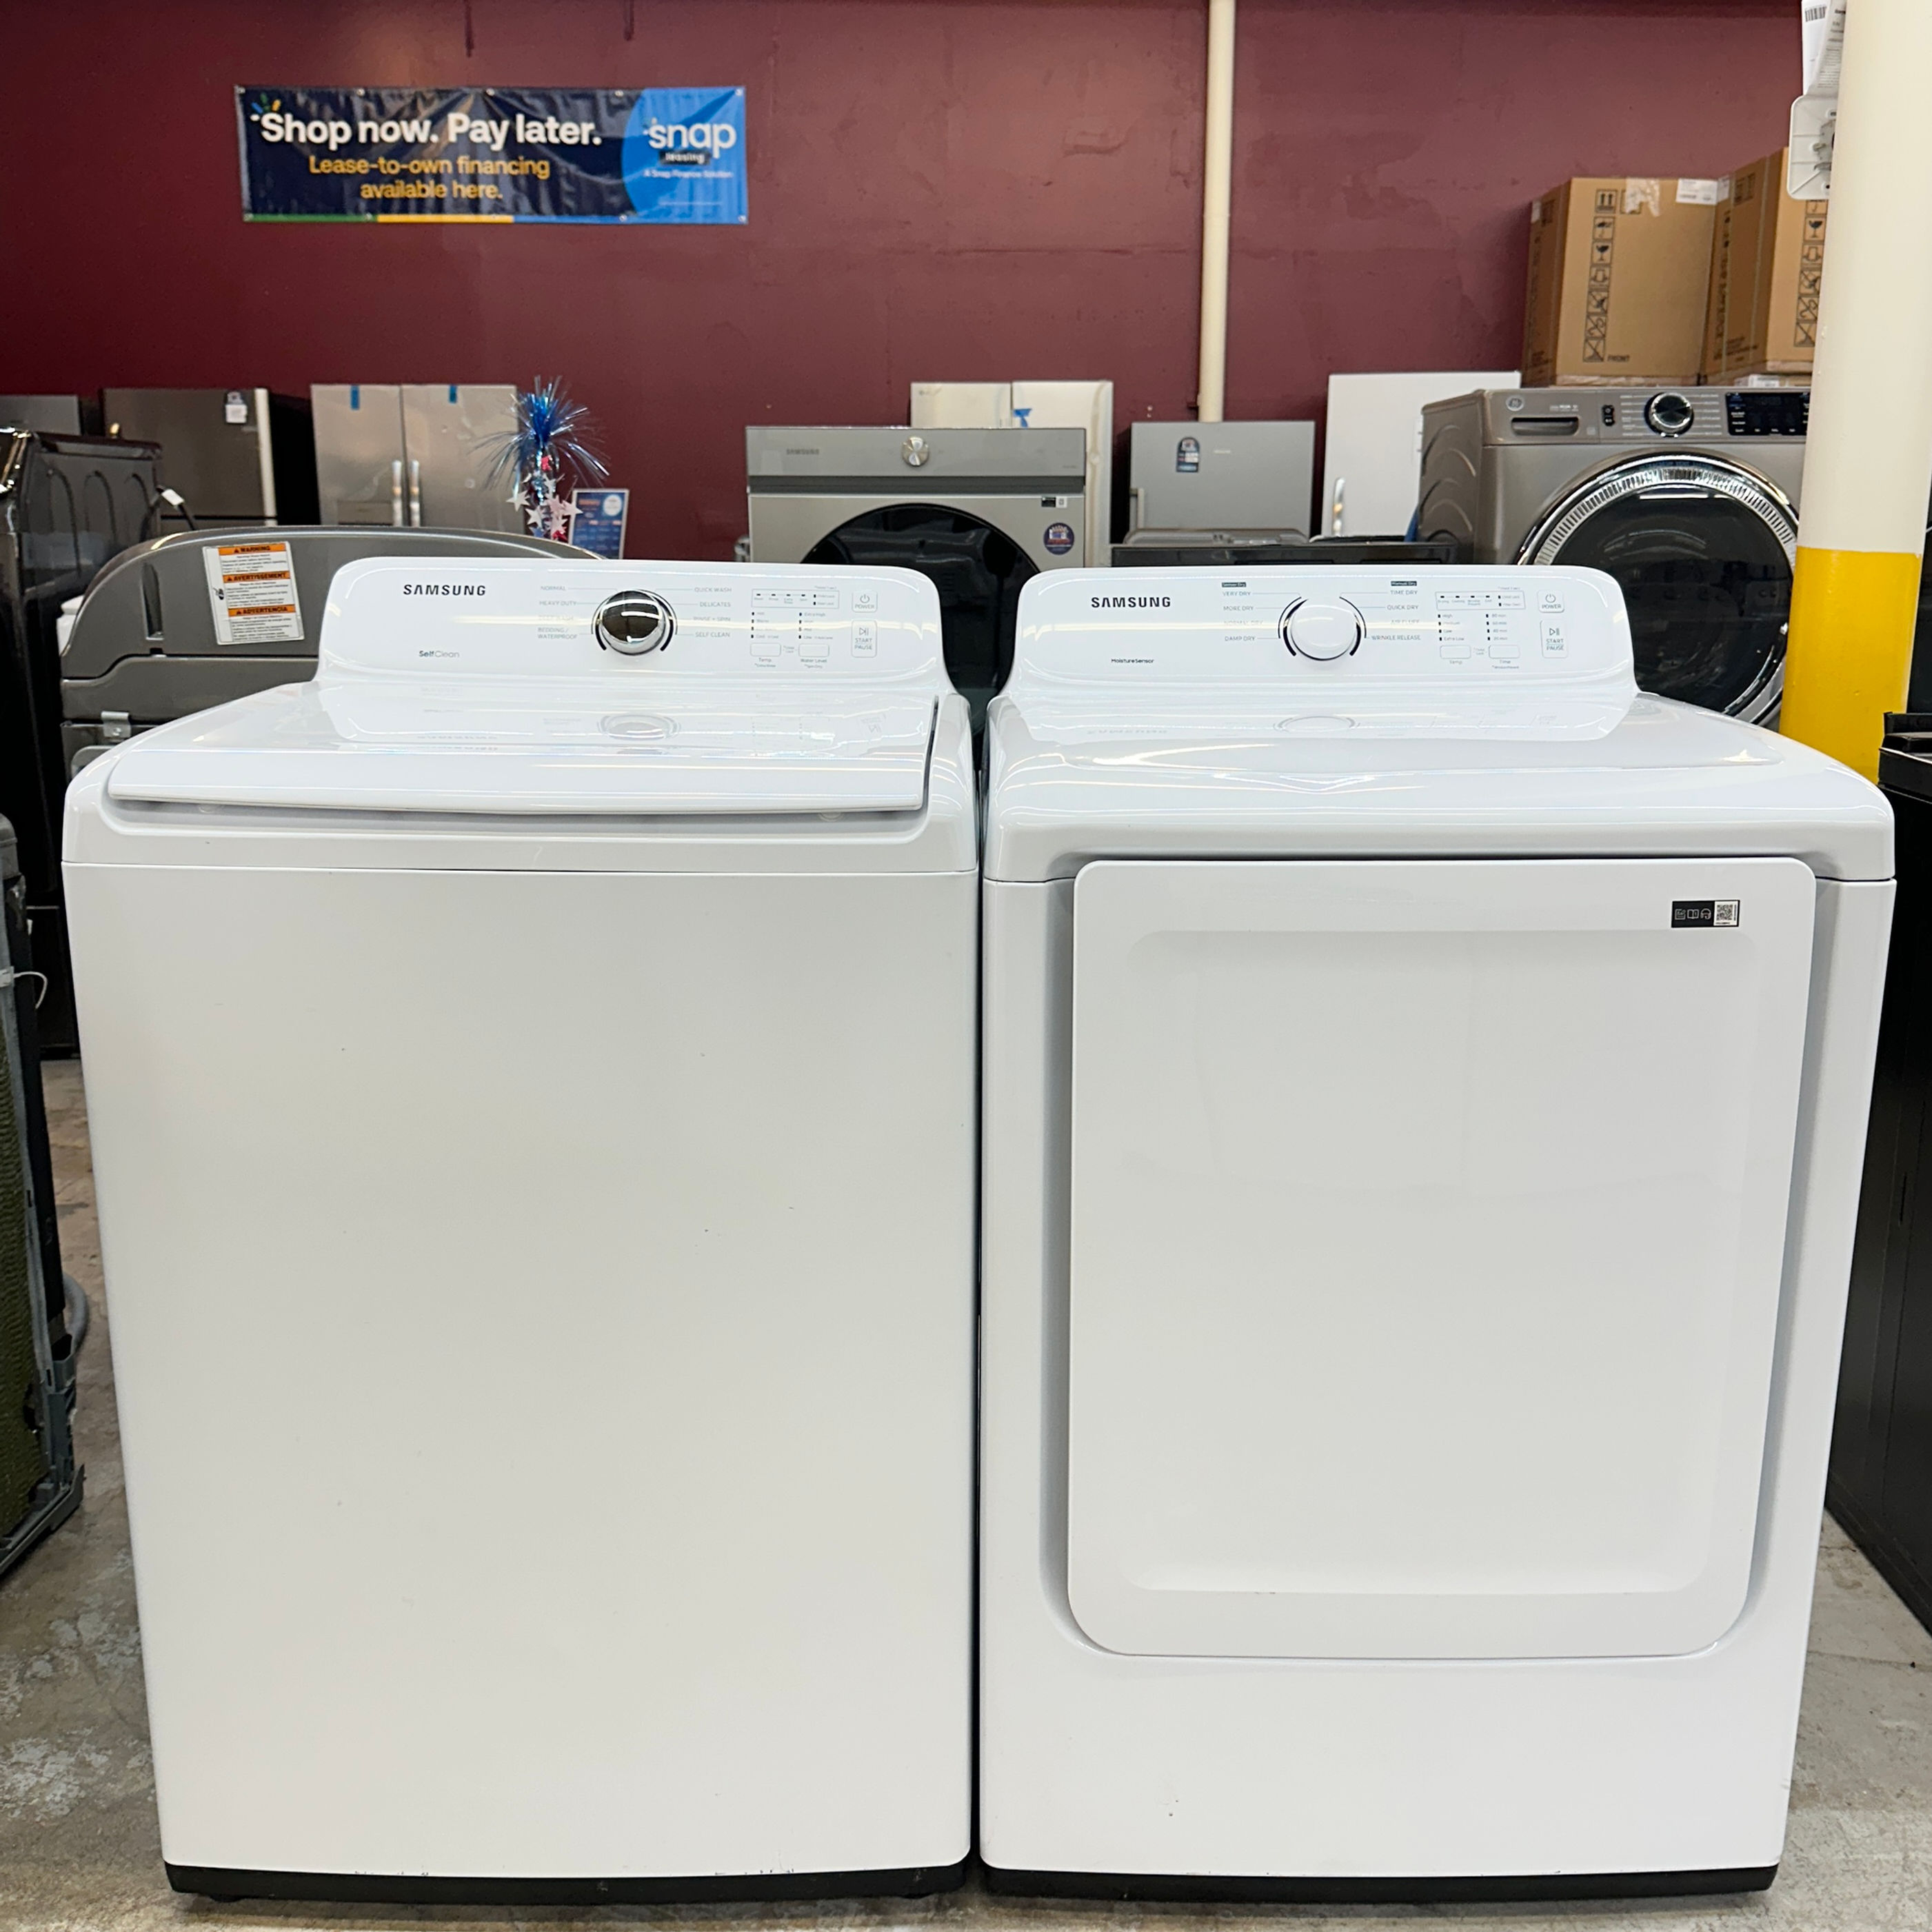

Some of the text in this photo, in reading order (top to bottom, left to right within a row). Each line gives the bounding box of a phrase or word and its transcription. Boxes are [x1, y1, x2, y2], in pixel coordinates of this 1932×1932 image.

[261, 112, 602, 151] Shop now. Pay later.
[649, 123, 736, 159] snap
[310, 155, 550, 179] Lease-to-own financing
[360, 180, 503, 199] available here.
[234, 572, 286, 581] AVERTISSEMENT
[403, 585, 486, 596] SAMSUNG
[1091, 597, 1171, 608] SAMSUNG
[243, 607, 288, 615] ADVERTENCIA
